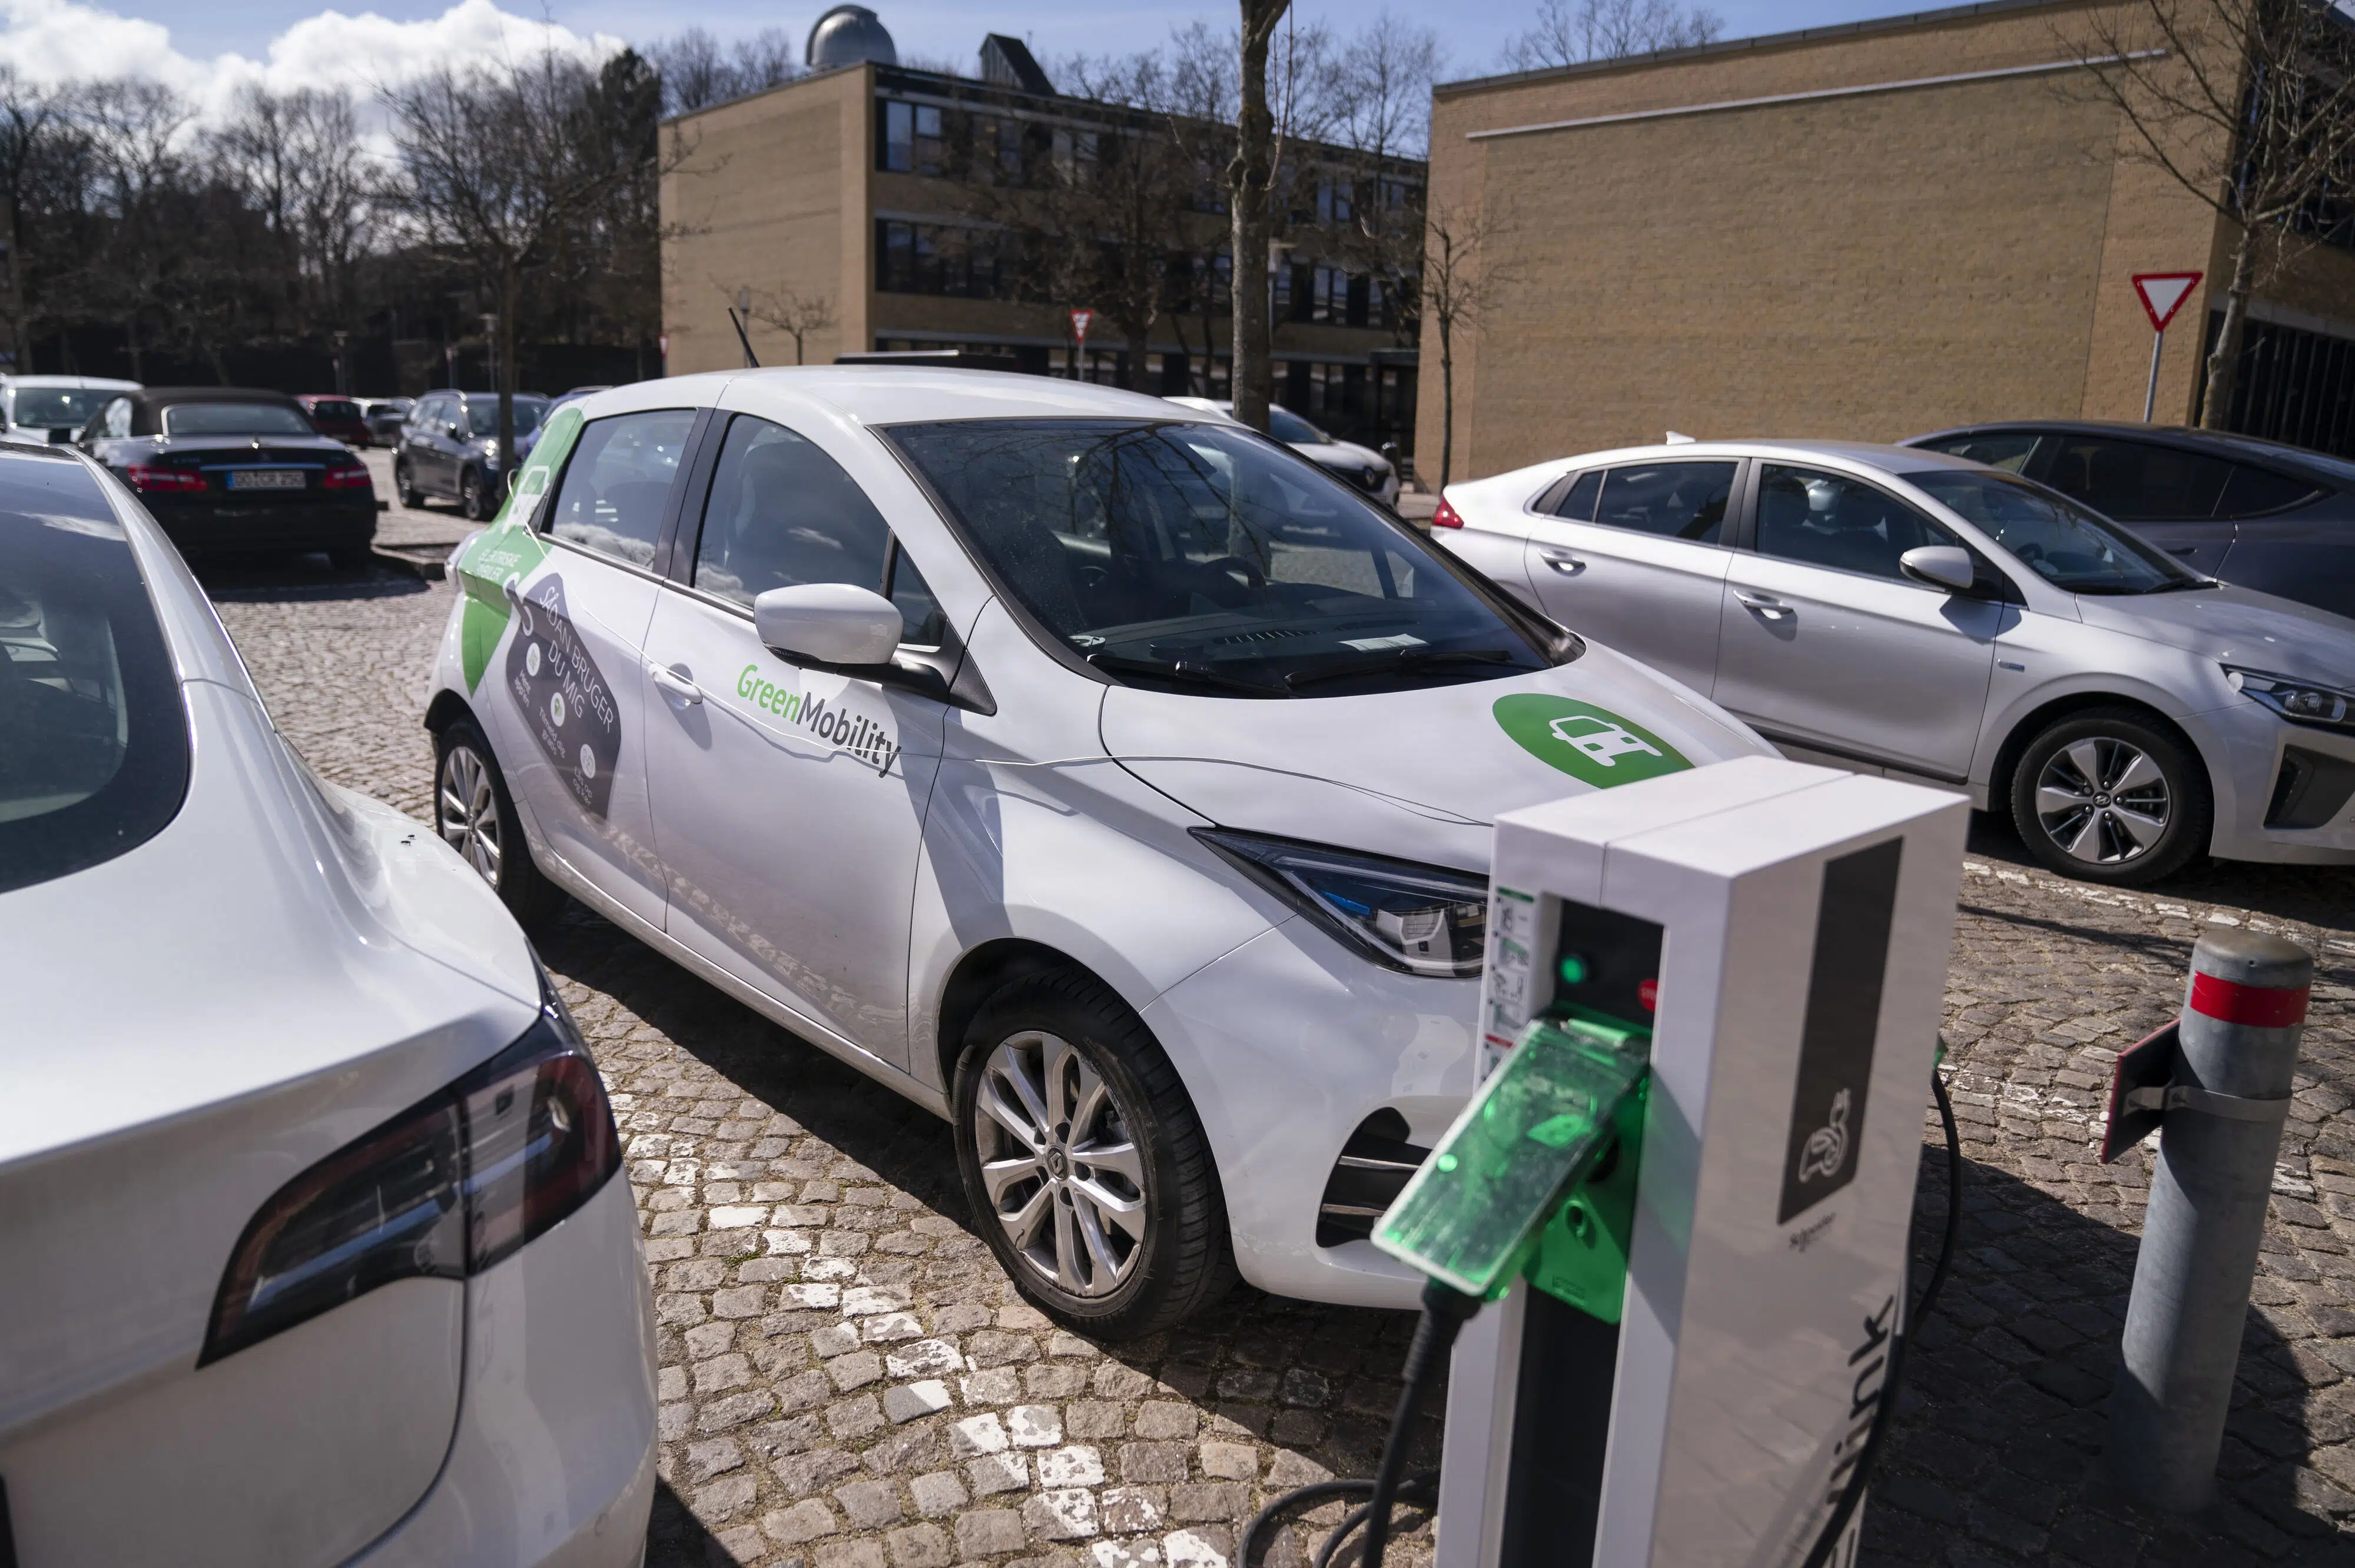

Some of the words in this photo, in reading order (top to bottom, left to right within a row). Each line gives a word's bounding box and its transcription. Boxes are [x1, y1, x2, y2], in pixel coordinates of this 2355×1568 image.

[539, 586, 572, 653] SÅDAN
[571, 645, 613, 733] BRUGER
[548, 639, 565, 677] DU
[563, 670, 585, 719] MIG
[737, 664, 902, 778] GreenMobility
